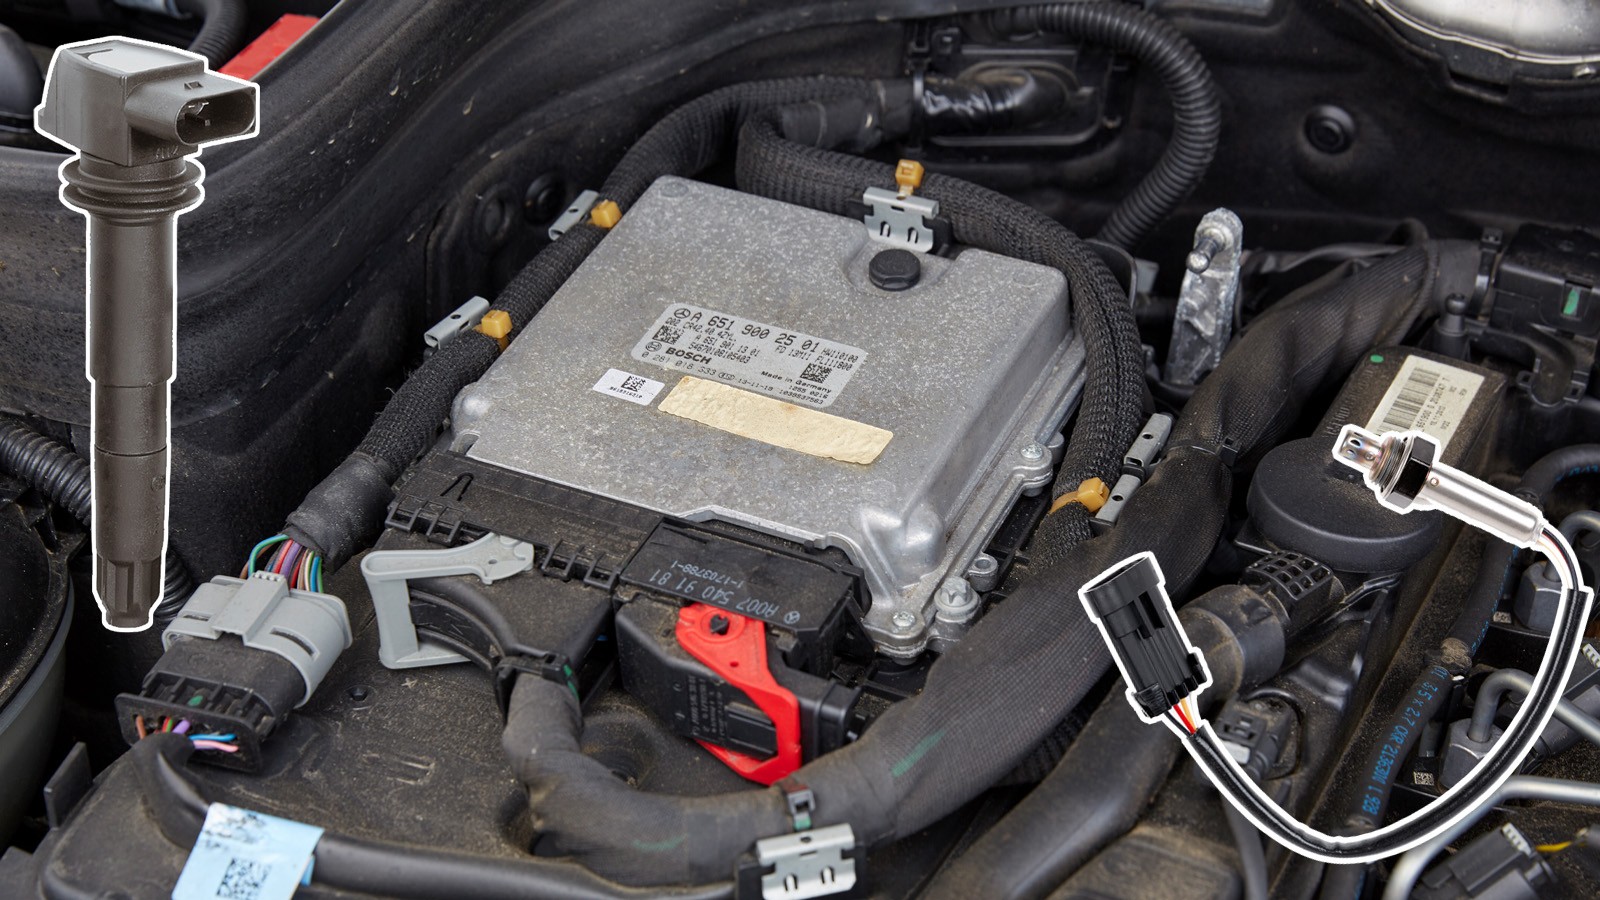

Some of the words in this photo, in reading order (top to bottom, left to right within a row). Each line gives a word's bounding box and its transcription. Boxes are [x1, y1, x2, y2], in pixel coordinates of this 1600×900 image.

[690, 312, 703, 322] A
[708, 316, 735, 330] 651
[741, 324, 770, 339] 900
[775, 333, 797, 346] 25
[801, 340, 820, 352] 01
[665, 347, 712, 365] BOSCH
[703, 336, 718, 346] 651
[720, 340, 735, 350] 901
[737, 345, 749, 354] 13
[750, 348, 760, 357] 01
[761, 370, 783, 380] Made
[795, 380, 832, 394] Germany
[649, 569, 672, 586] 81
[675, 577, 698, 593] 91
[701, 585, 735, 605] 540
[735, 597, 780, 617] A007
